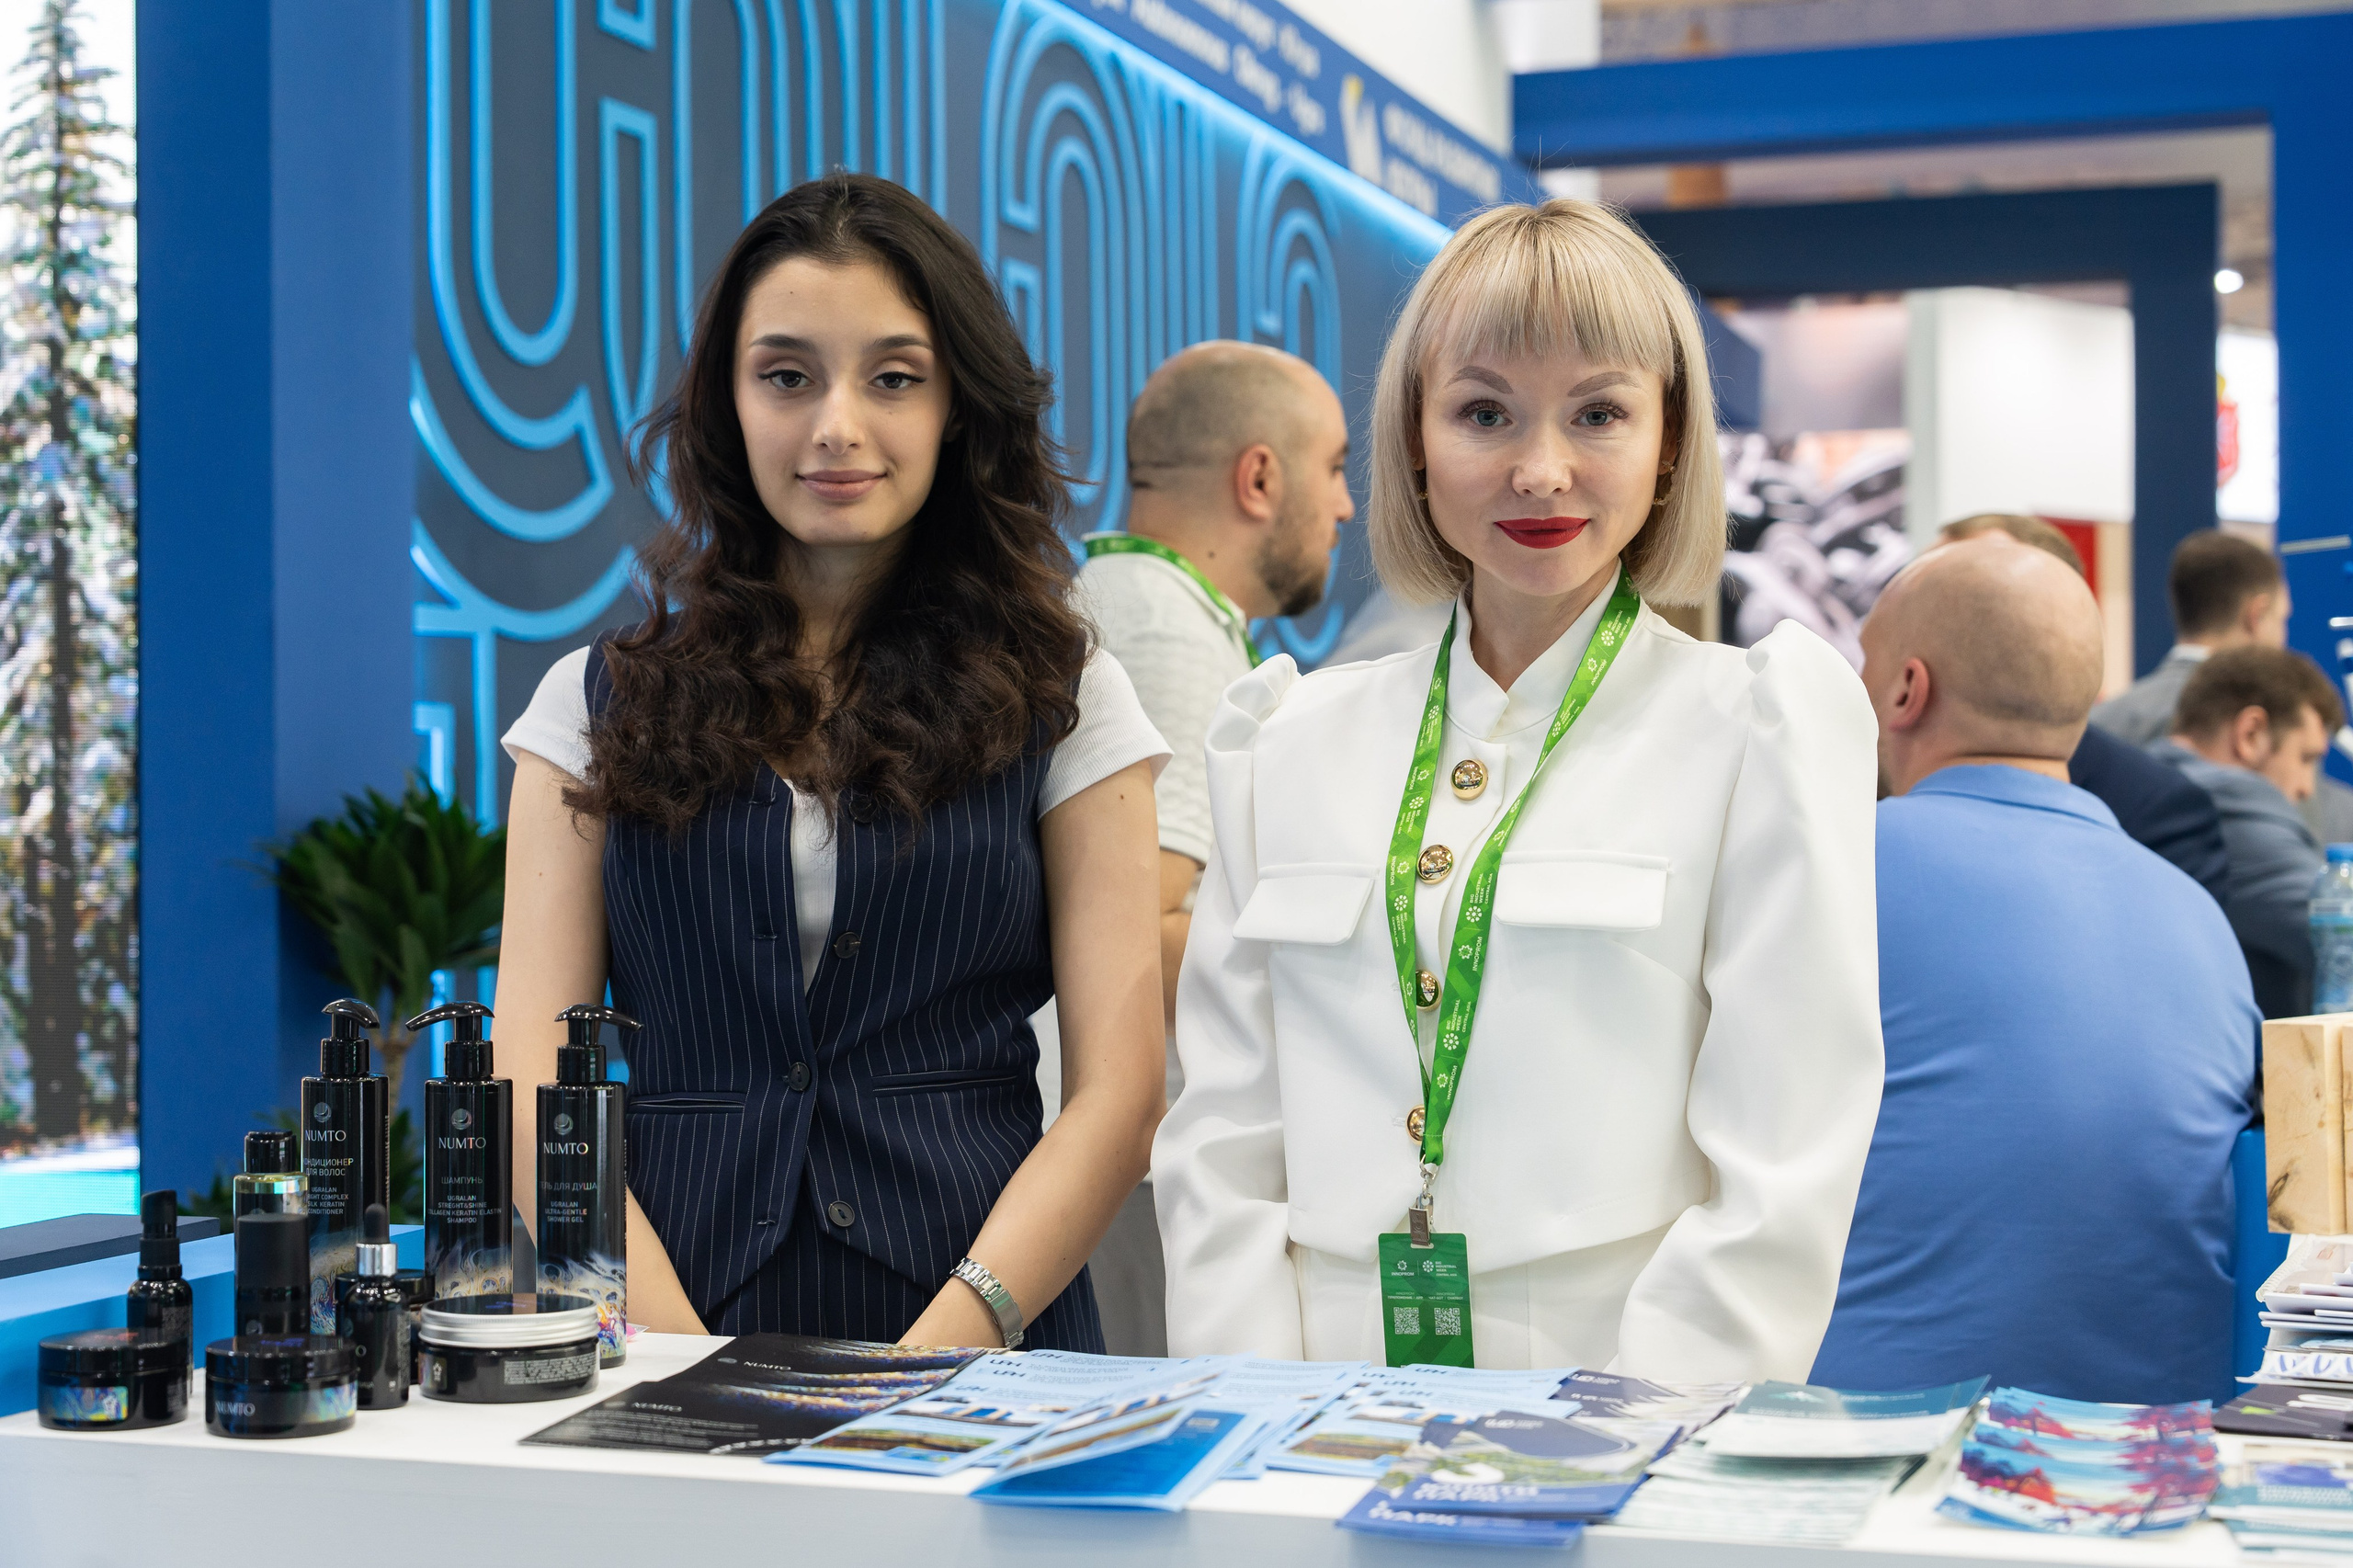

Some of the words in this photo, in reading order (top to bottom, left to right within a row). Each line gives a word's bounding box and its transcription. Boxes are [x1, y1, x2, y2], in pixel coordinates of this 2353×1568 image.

[1591, 659, 1607, 686] INNOPROM
[1409, 767, 1418, 790] INNOPROM
[1474, 873, 1483, 903] INDUSTRIAL
[1472, 936, 1483, 971] INNOPROM
[1450, 999, 1461, 1030] INDUSTRIAL
[1447, 1065, 1458, 1100] INNOPROM
[305, 1130, 347, 1142] NUMTO
[438, 1137, 486, 1149] NUMTO
[543, 1142, 588, 1154] NUMTO
[303, 1158, 354, 1167] ОНДИЦИОНЕР
[305, 1167, 318, 1176] ДЛЯ
[319, 1168, 346, 1176] ВОЛОС
[553, 1182, 570, 1191] ДЛЯ
[572, 1182, 597, 1191] ДУША
[744, 1360, 791, 1370] NUMTO
[215, 1401, 256, 1416] NUMTO
